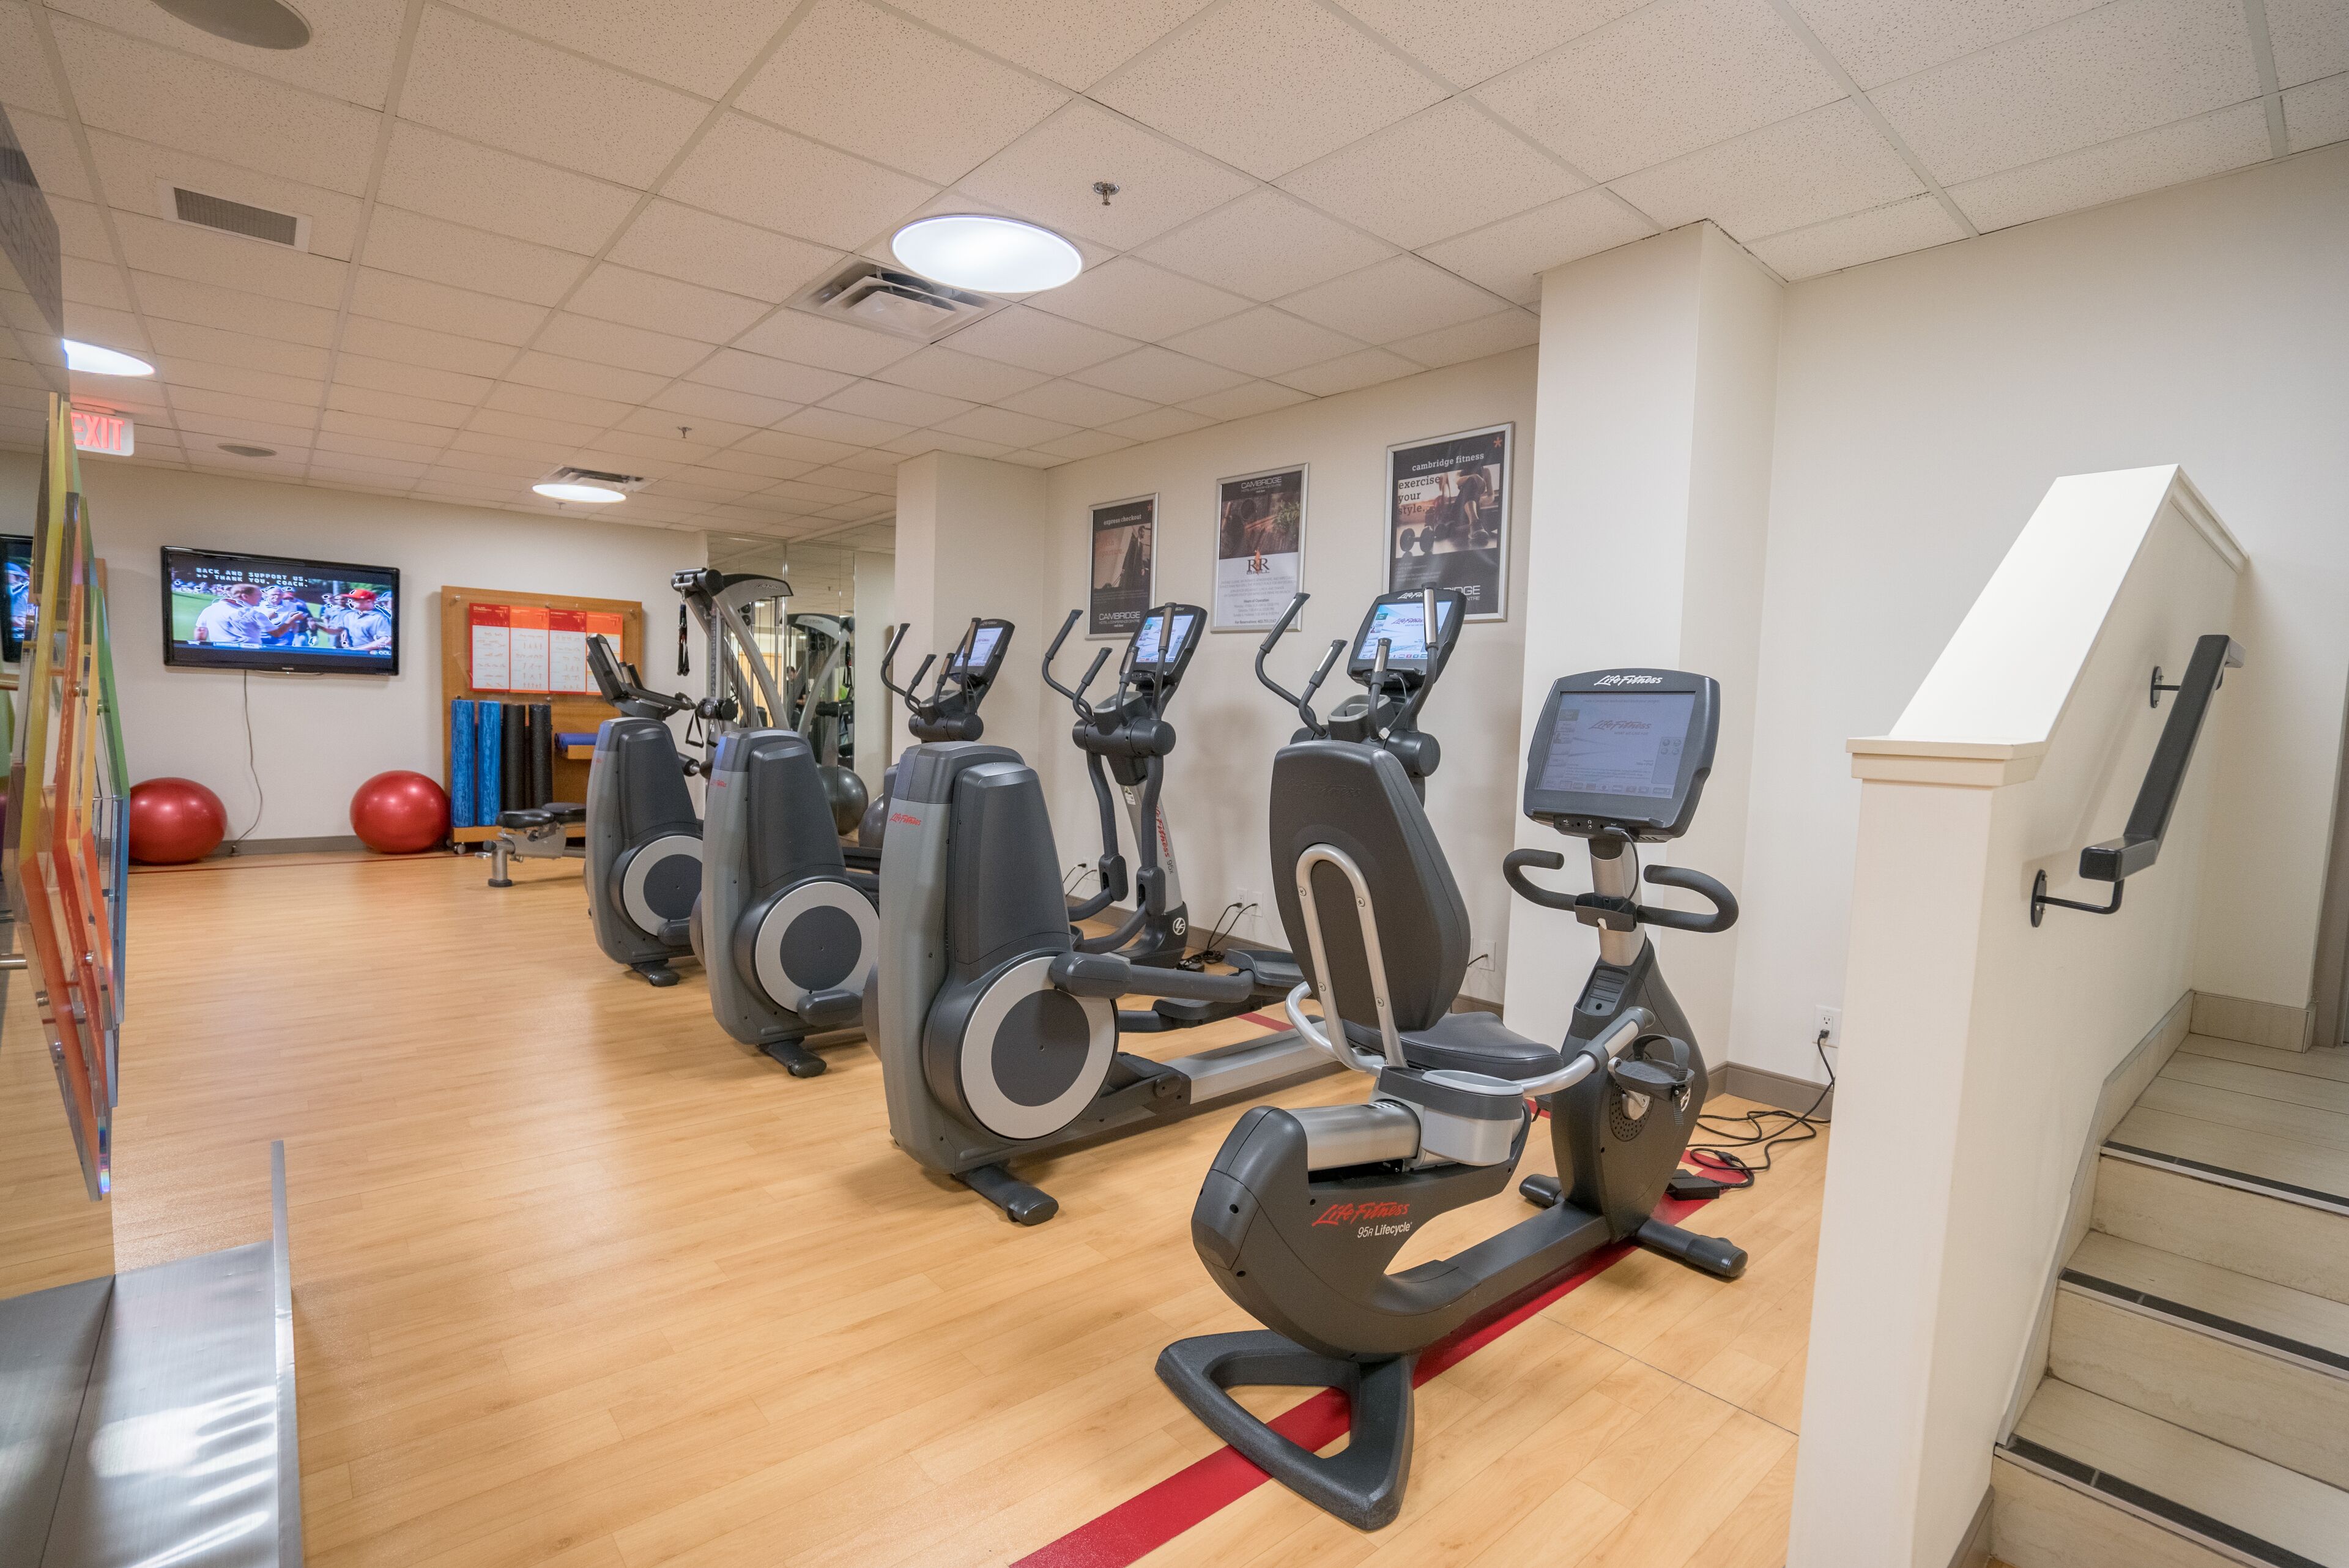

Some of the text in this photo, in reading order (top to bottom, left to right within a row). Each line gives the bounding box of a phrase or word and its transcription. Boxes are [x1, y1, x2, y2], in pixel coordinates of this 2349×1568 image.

[70, 412, 125, 451] EXIT
[1412, 453, 1484, 471] cambridge fitness
[1241, 476, 1282, 489] CAMBRIDGE
[1398, 476, 1441, 489] exercise
[1398, 492, 1421, 505] your
[1099, 611, 1140, 620] CAMBRIDGE
[1594, 675, 1663, 686] Life Fitness
[1312, 1202, 1410, 1227] Life Fitness
